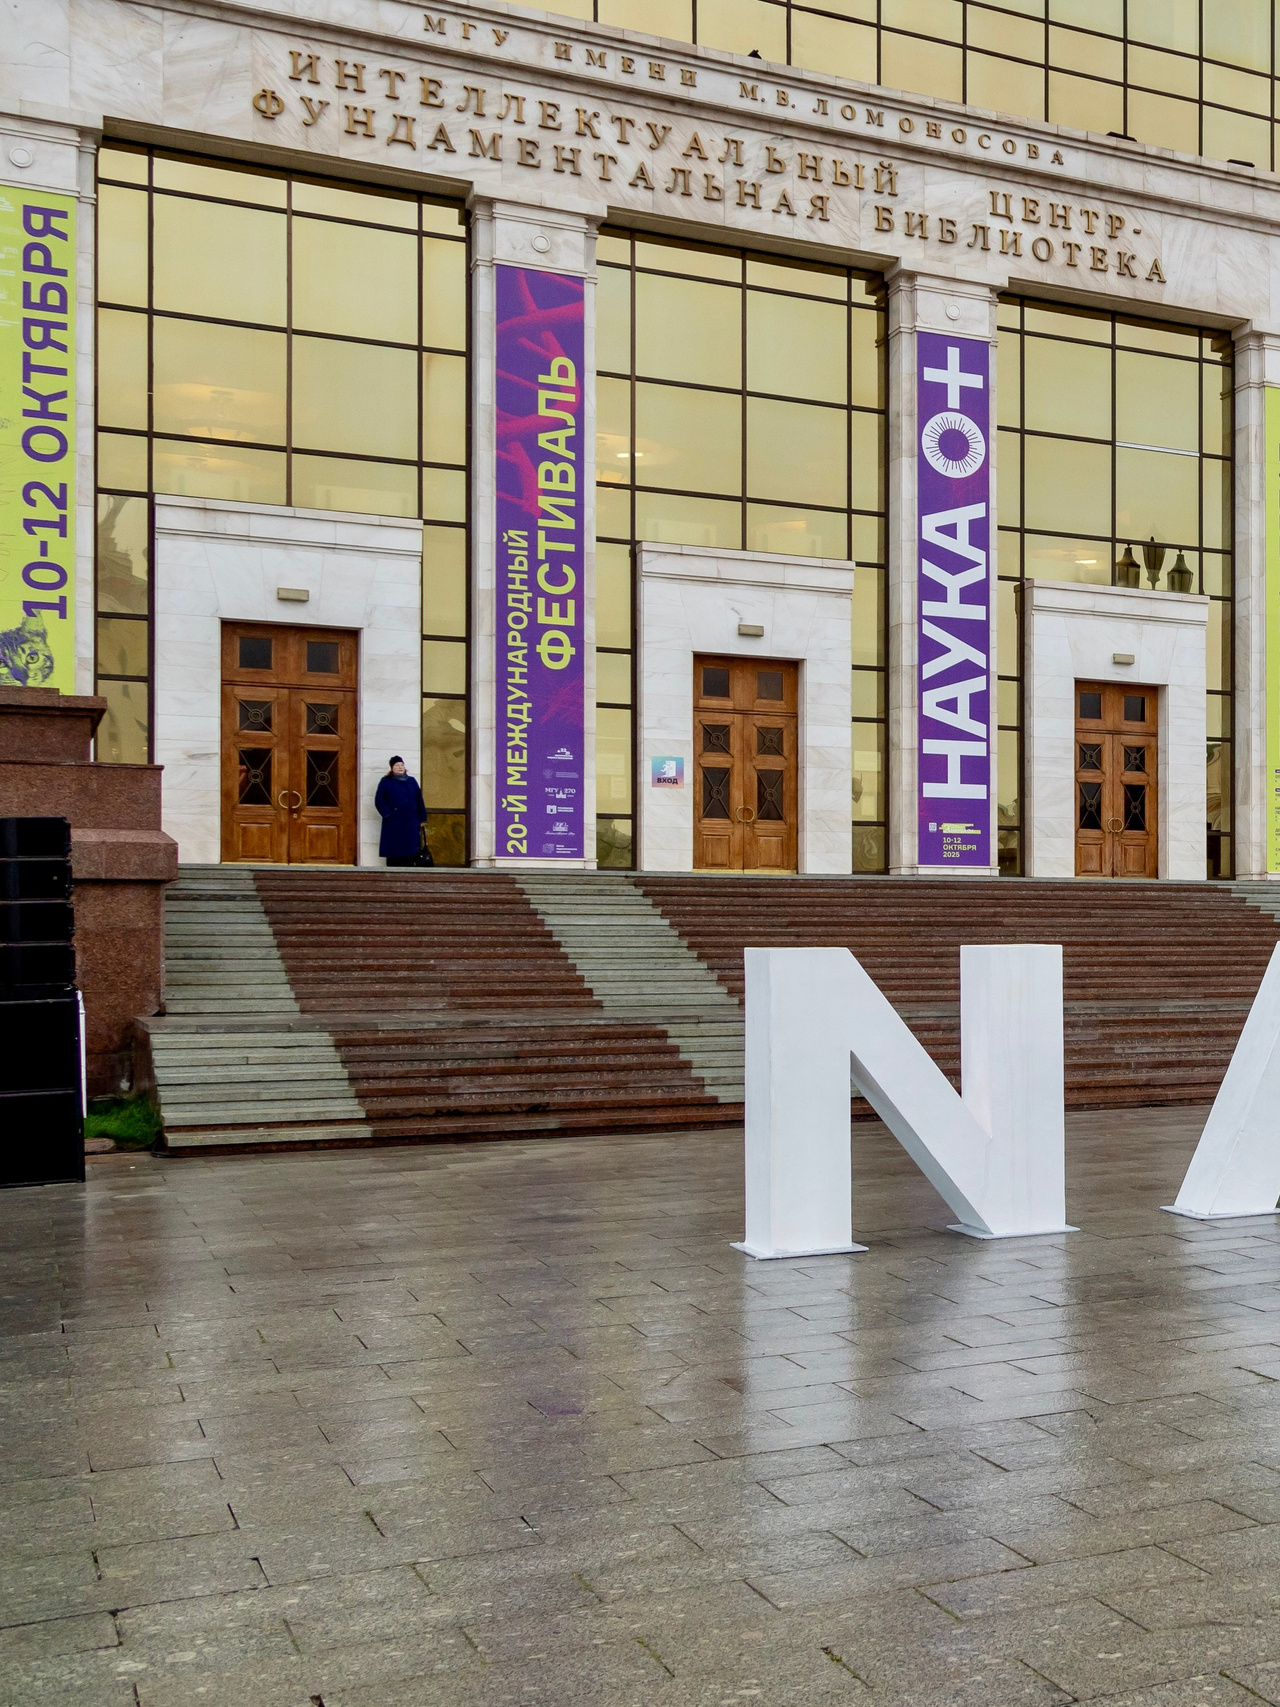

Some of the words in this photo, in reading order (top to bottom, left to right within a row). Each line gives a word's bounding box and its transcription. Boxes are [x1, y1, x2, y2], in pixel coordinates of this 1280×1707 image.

[288, 50, 899, 197] ИНТЕЛЛЕКТУАЛЬНЫЙ
[424, 13, 509, 46] МГУ
[555, 41, 697, 88] ИМЕНИ
[812, 97, 1065, 165] ЛОМОНОСОВА
[252, 88, 829, 222] ФУНДАМЕНТАЛЬНАЯ
[875, 205, 1167, 284] БИБЛИОТЕКА
[21, 204, 68, 463] ОКТЯБРЯ
[22, 481, 68, 619] 10-12
[536, 356, 576, 670] ФЕСТИВАЛЬ
[502, 530, 532, 786] МЕЖДУНАРОДНЫЙ
[922, 502, 987, 800] НАУКА
[501, 795, 528, 854] 20-Й
[656, 777, 679, 785] ВХОД
